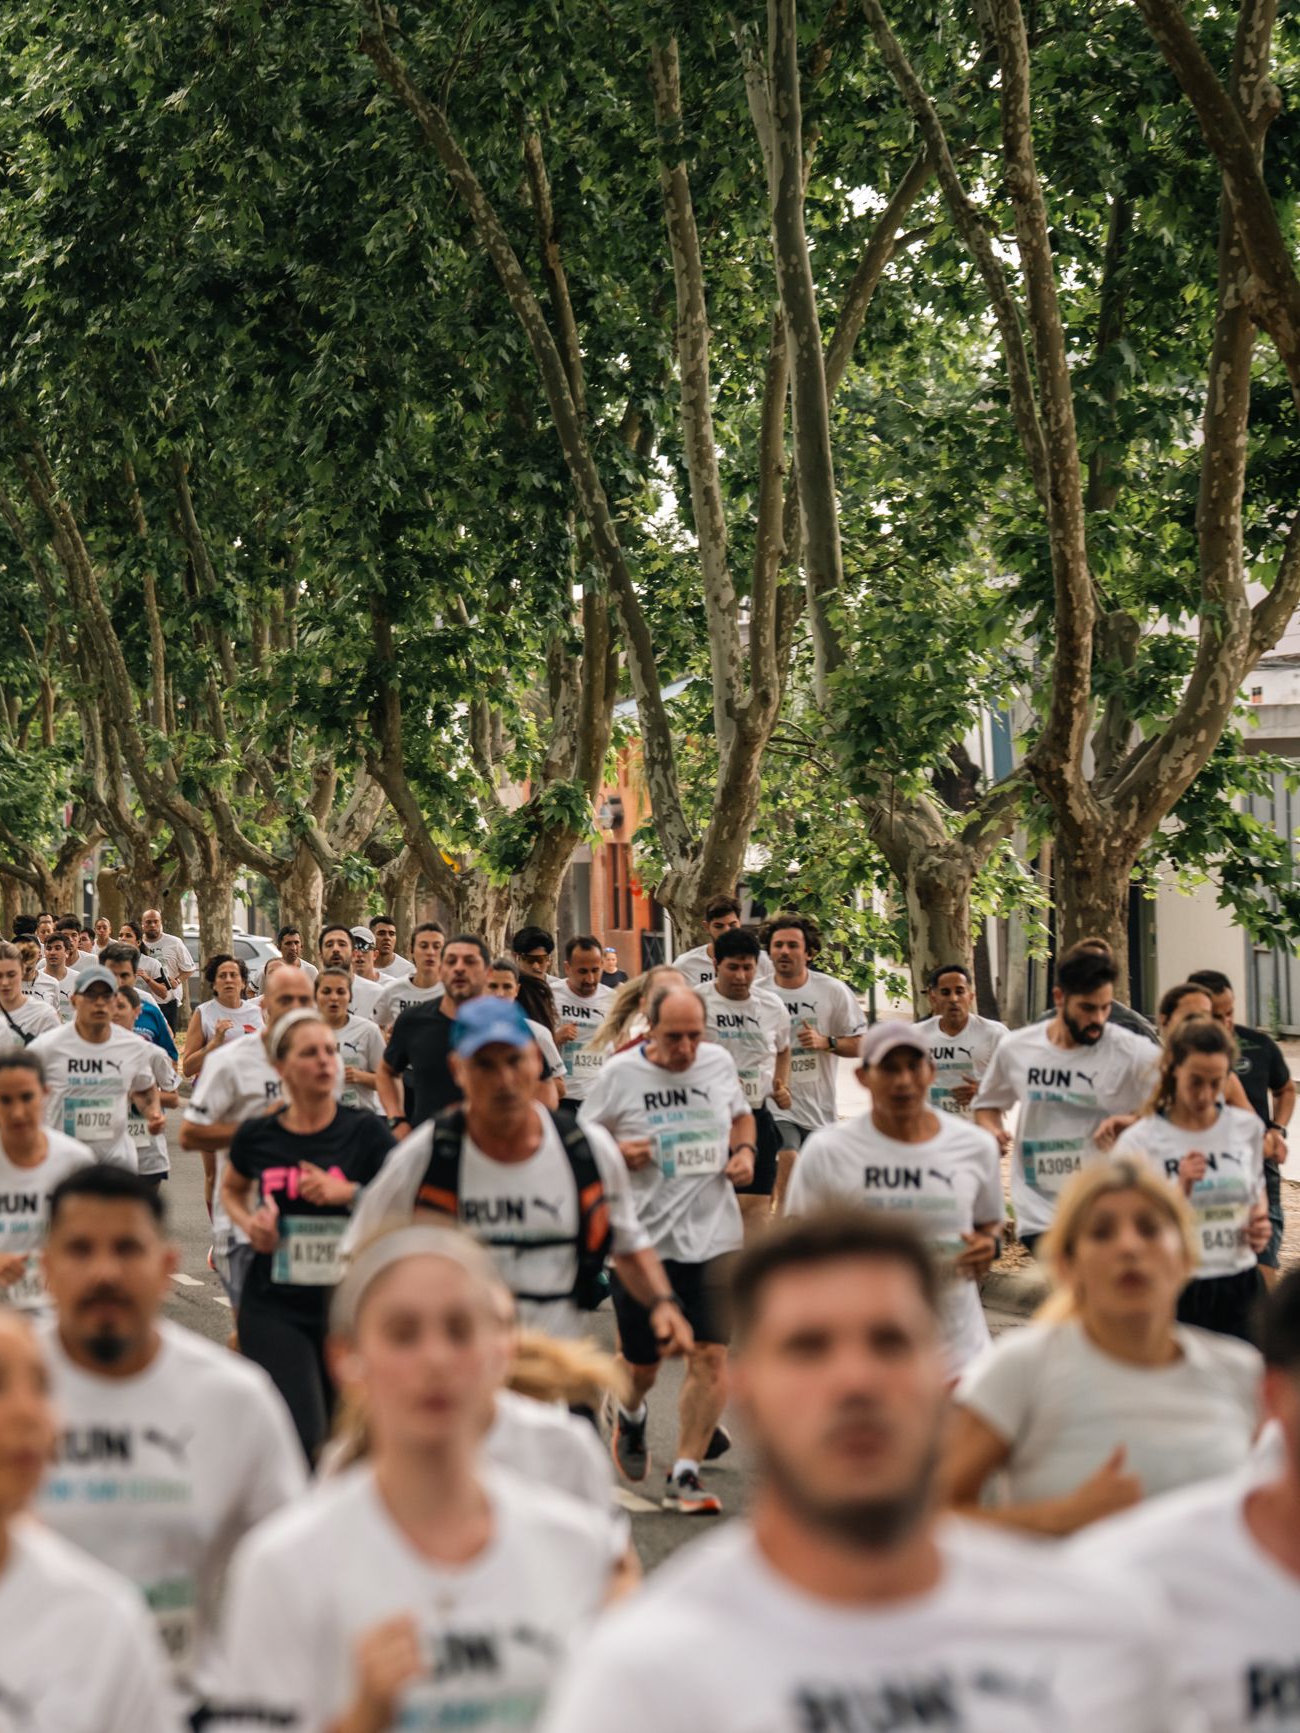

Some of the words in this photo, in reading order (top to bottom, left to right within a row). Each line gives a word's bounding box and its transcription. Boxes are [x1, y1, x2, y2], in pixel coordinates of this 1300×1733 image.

[562, 1005, 591, 1019] RUN
[716, 1014, 744, 1028] RUN
[67, 1059, 102, 1074] RUN
[1027, 1067, 1071, 1088] RUN
[644, 1087, 688, 1111] RUN
[77, 1113, 112, 1127] A0702
[1165, 1153, 1219, 1179] RN
[864, 1166, 922, 1190] RUN
[463, 1197, 525, 1225] RUN
